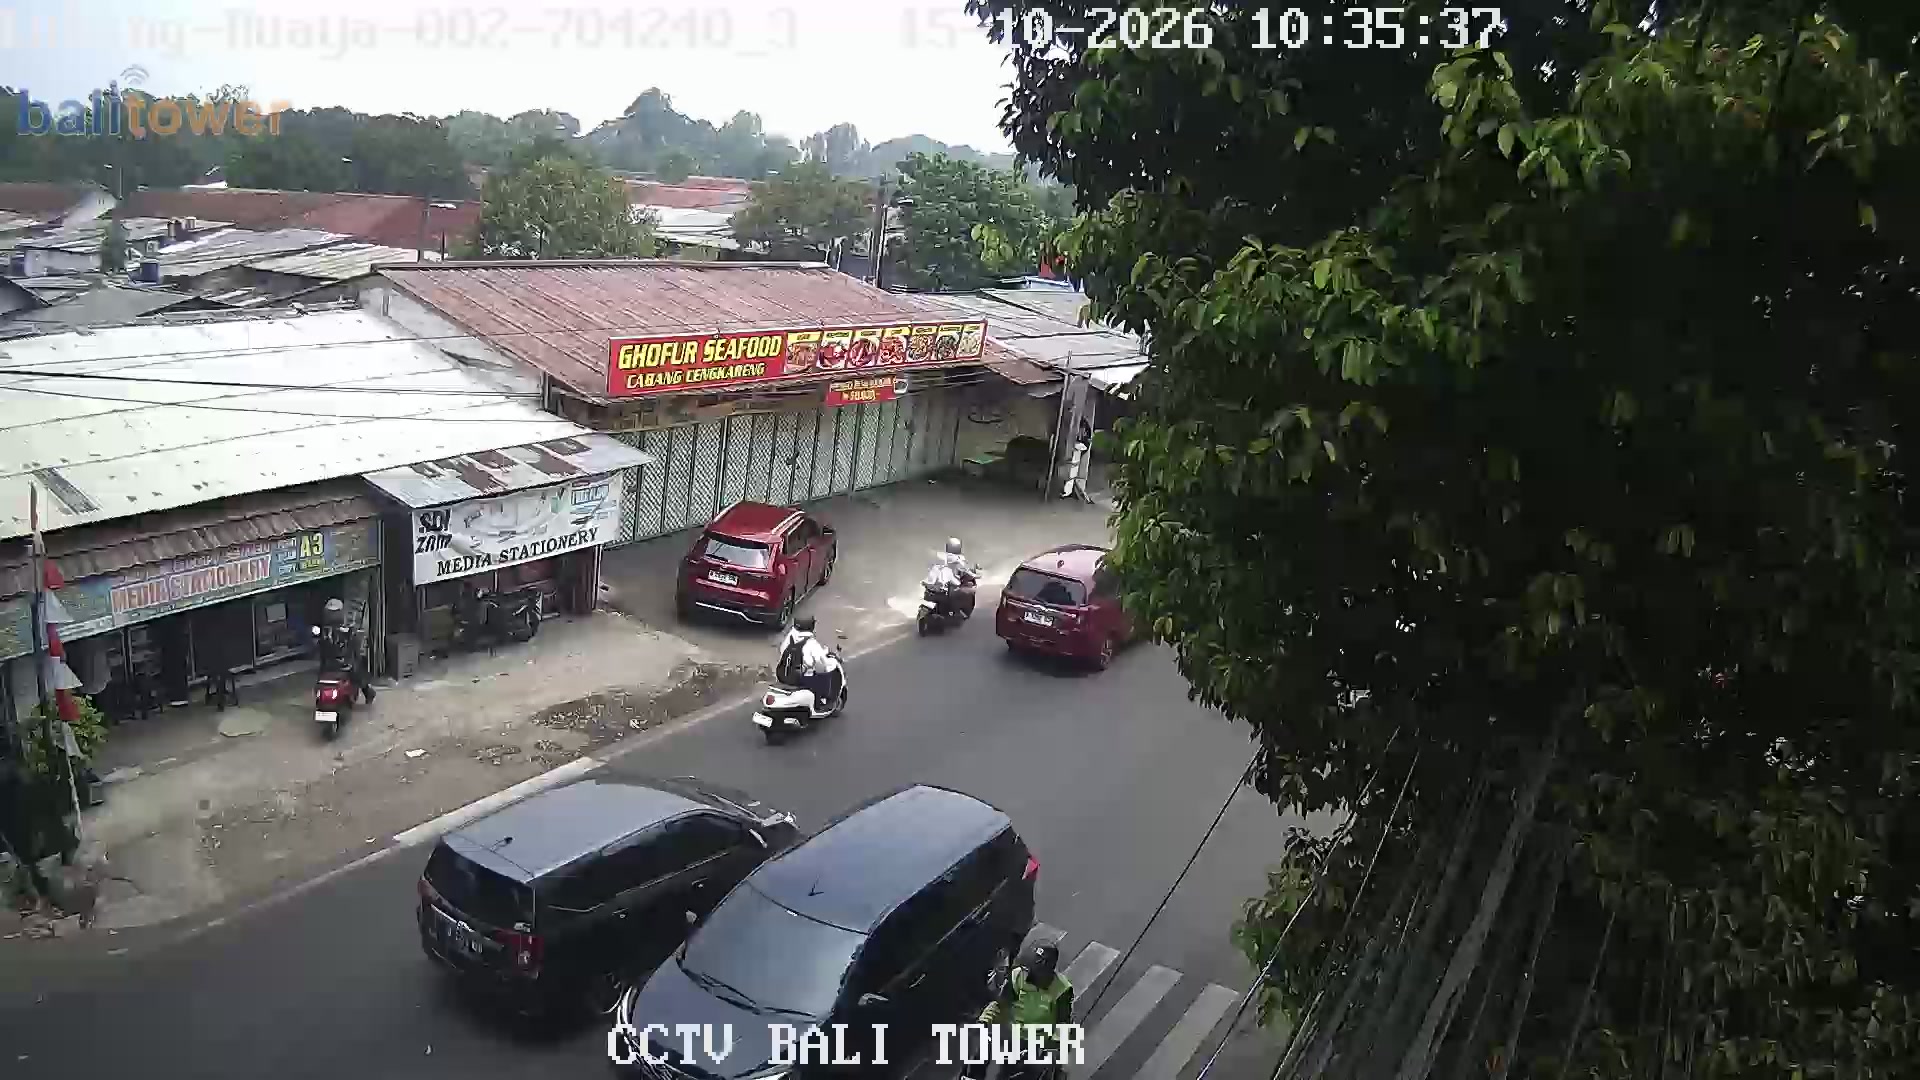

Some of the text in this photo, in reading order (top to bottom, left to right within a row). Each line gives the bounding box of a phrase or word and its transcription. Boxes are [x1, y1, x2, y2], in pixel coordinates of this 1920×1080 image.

[618, 335, 783, 370] GHOFUR SEAFOOD
[626, 362, 766, 389] CABANG CENGKARENG
[301, 532, 324, 558] A3
[436, 526, 600, 577] MEDIA STATIONERY
